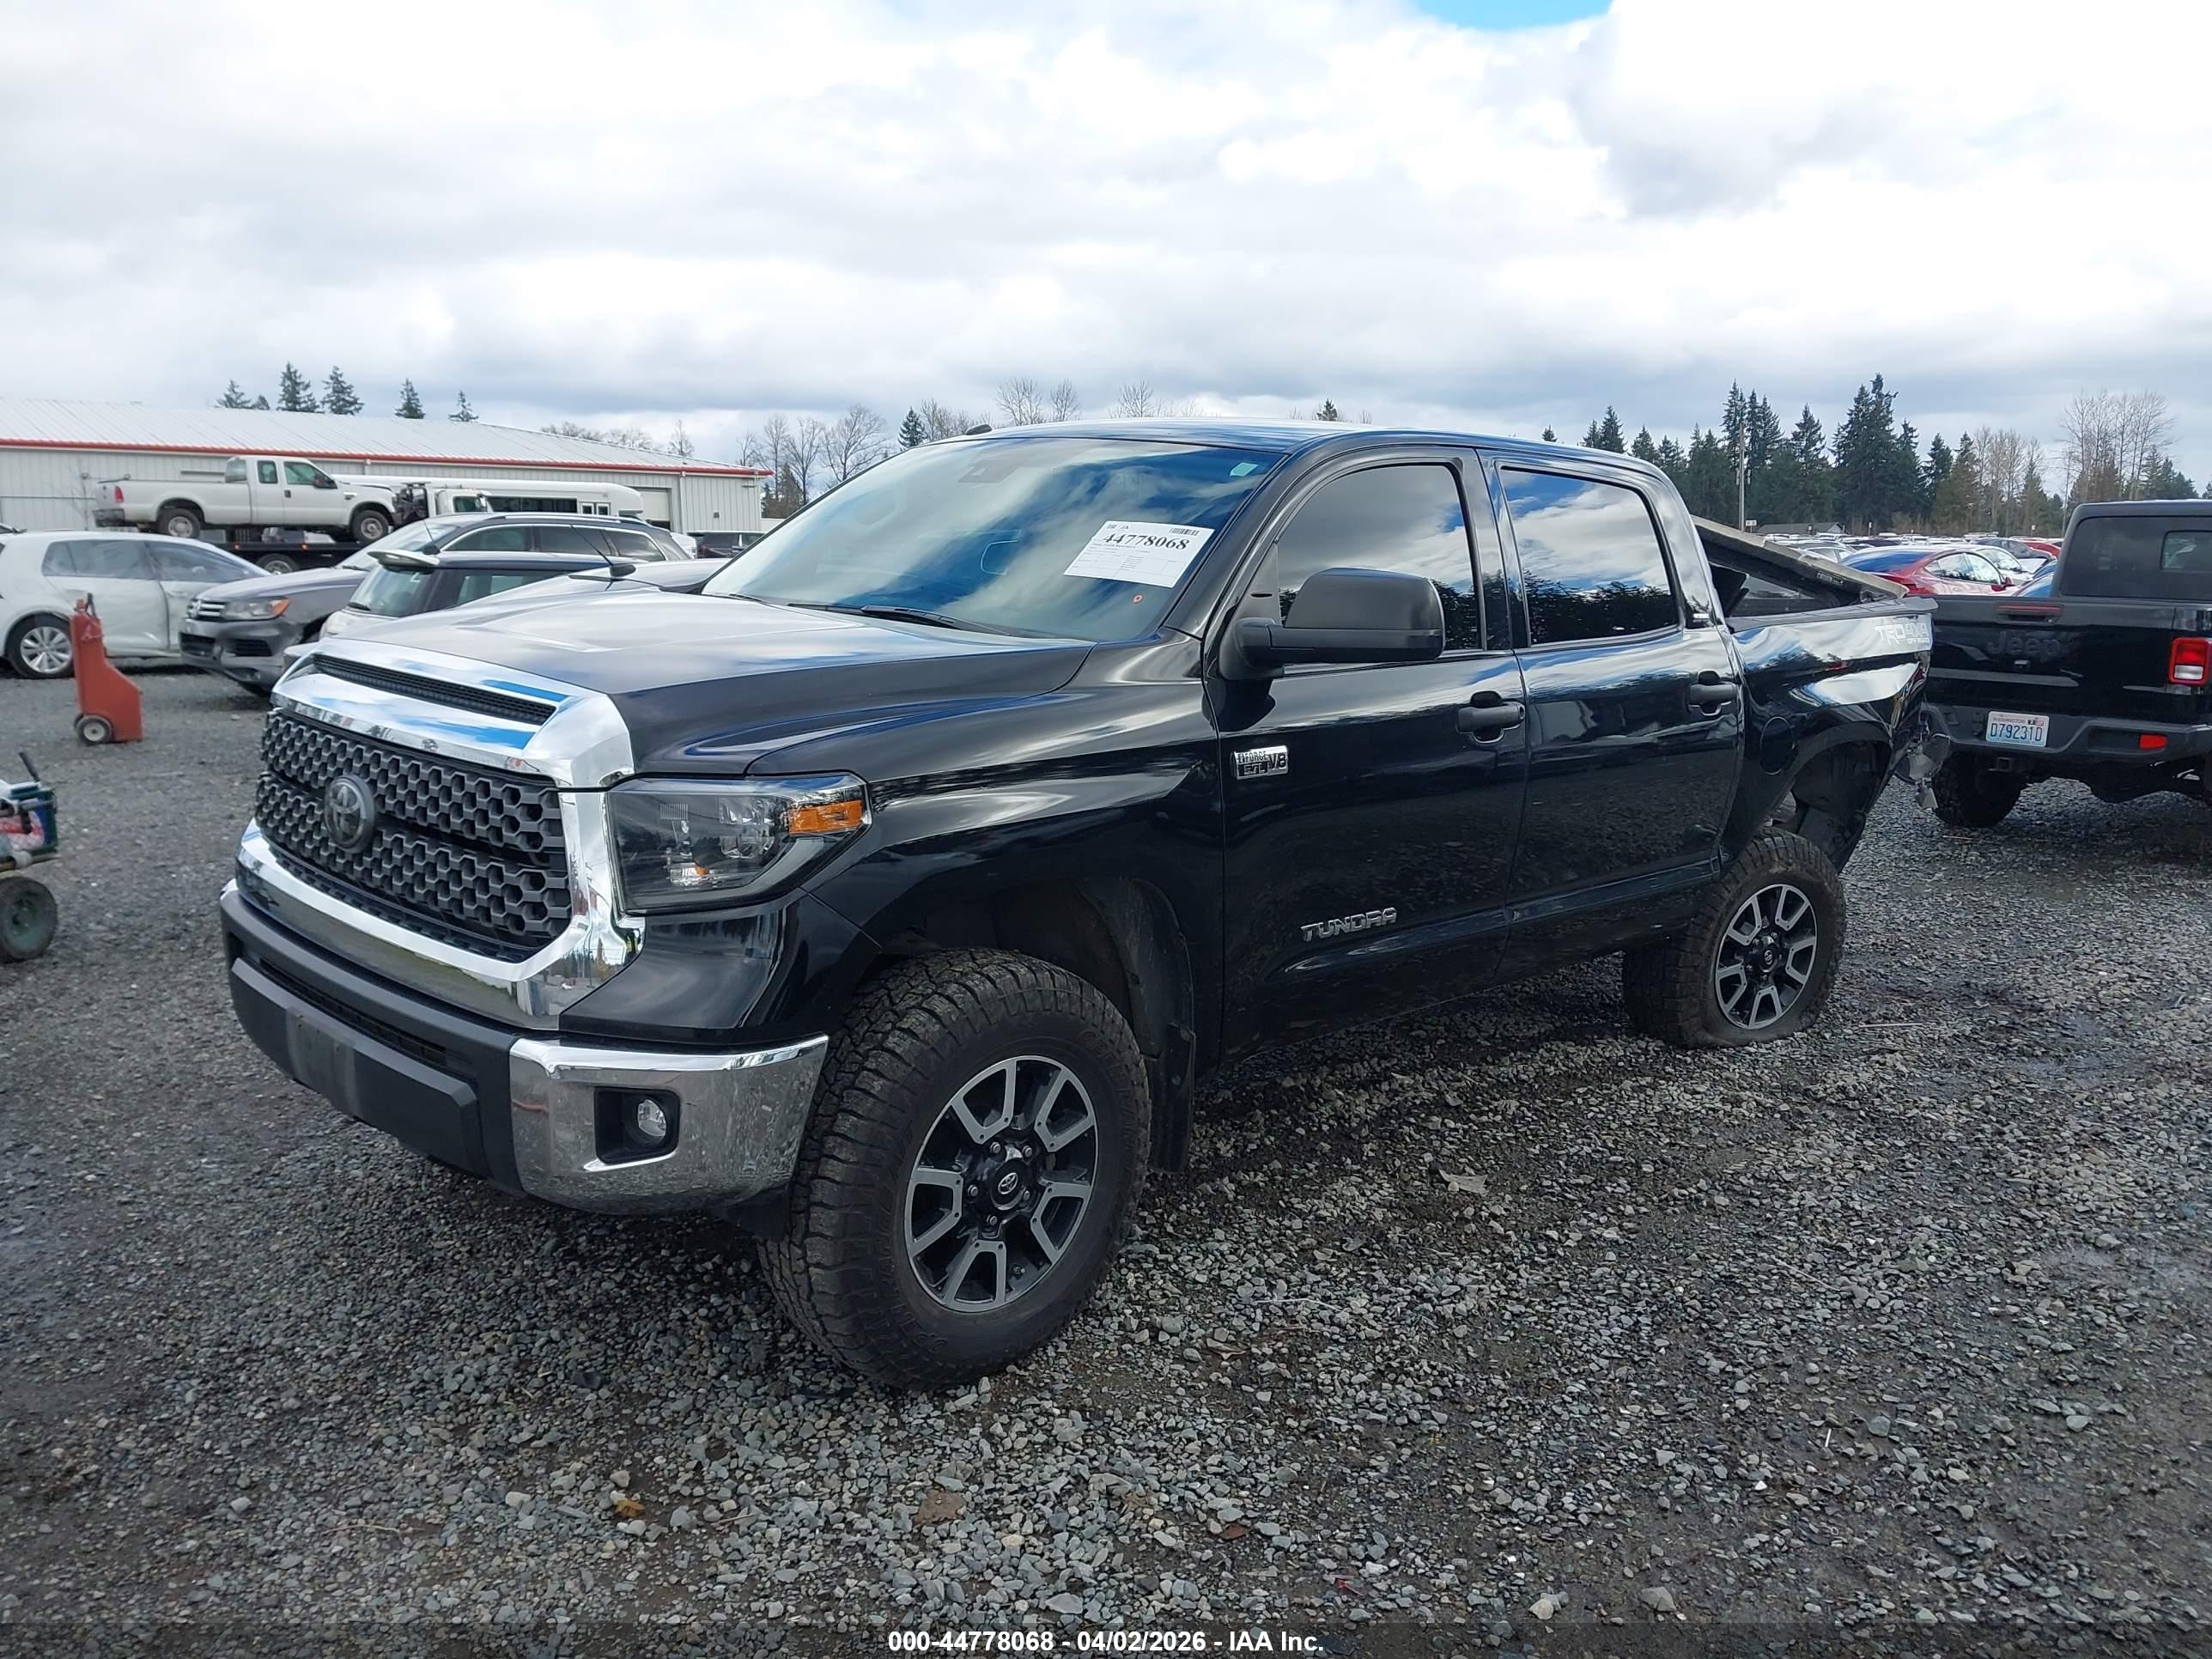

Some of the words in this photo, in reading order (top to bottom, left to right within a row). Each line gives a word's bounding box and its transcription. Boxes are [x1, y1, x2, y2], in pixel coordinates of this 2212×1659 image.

[1103, 533, 1190, 550] 44778068
[1875, 623, 1905, 646] TRD
[1987, 631, 2061, 663] Jeep
[1990, 722, 2043, 741] D79231D
[1268, 752, 1287, 769] V8
[1300, 907, 1398, 942] TUNDRA
